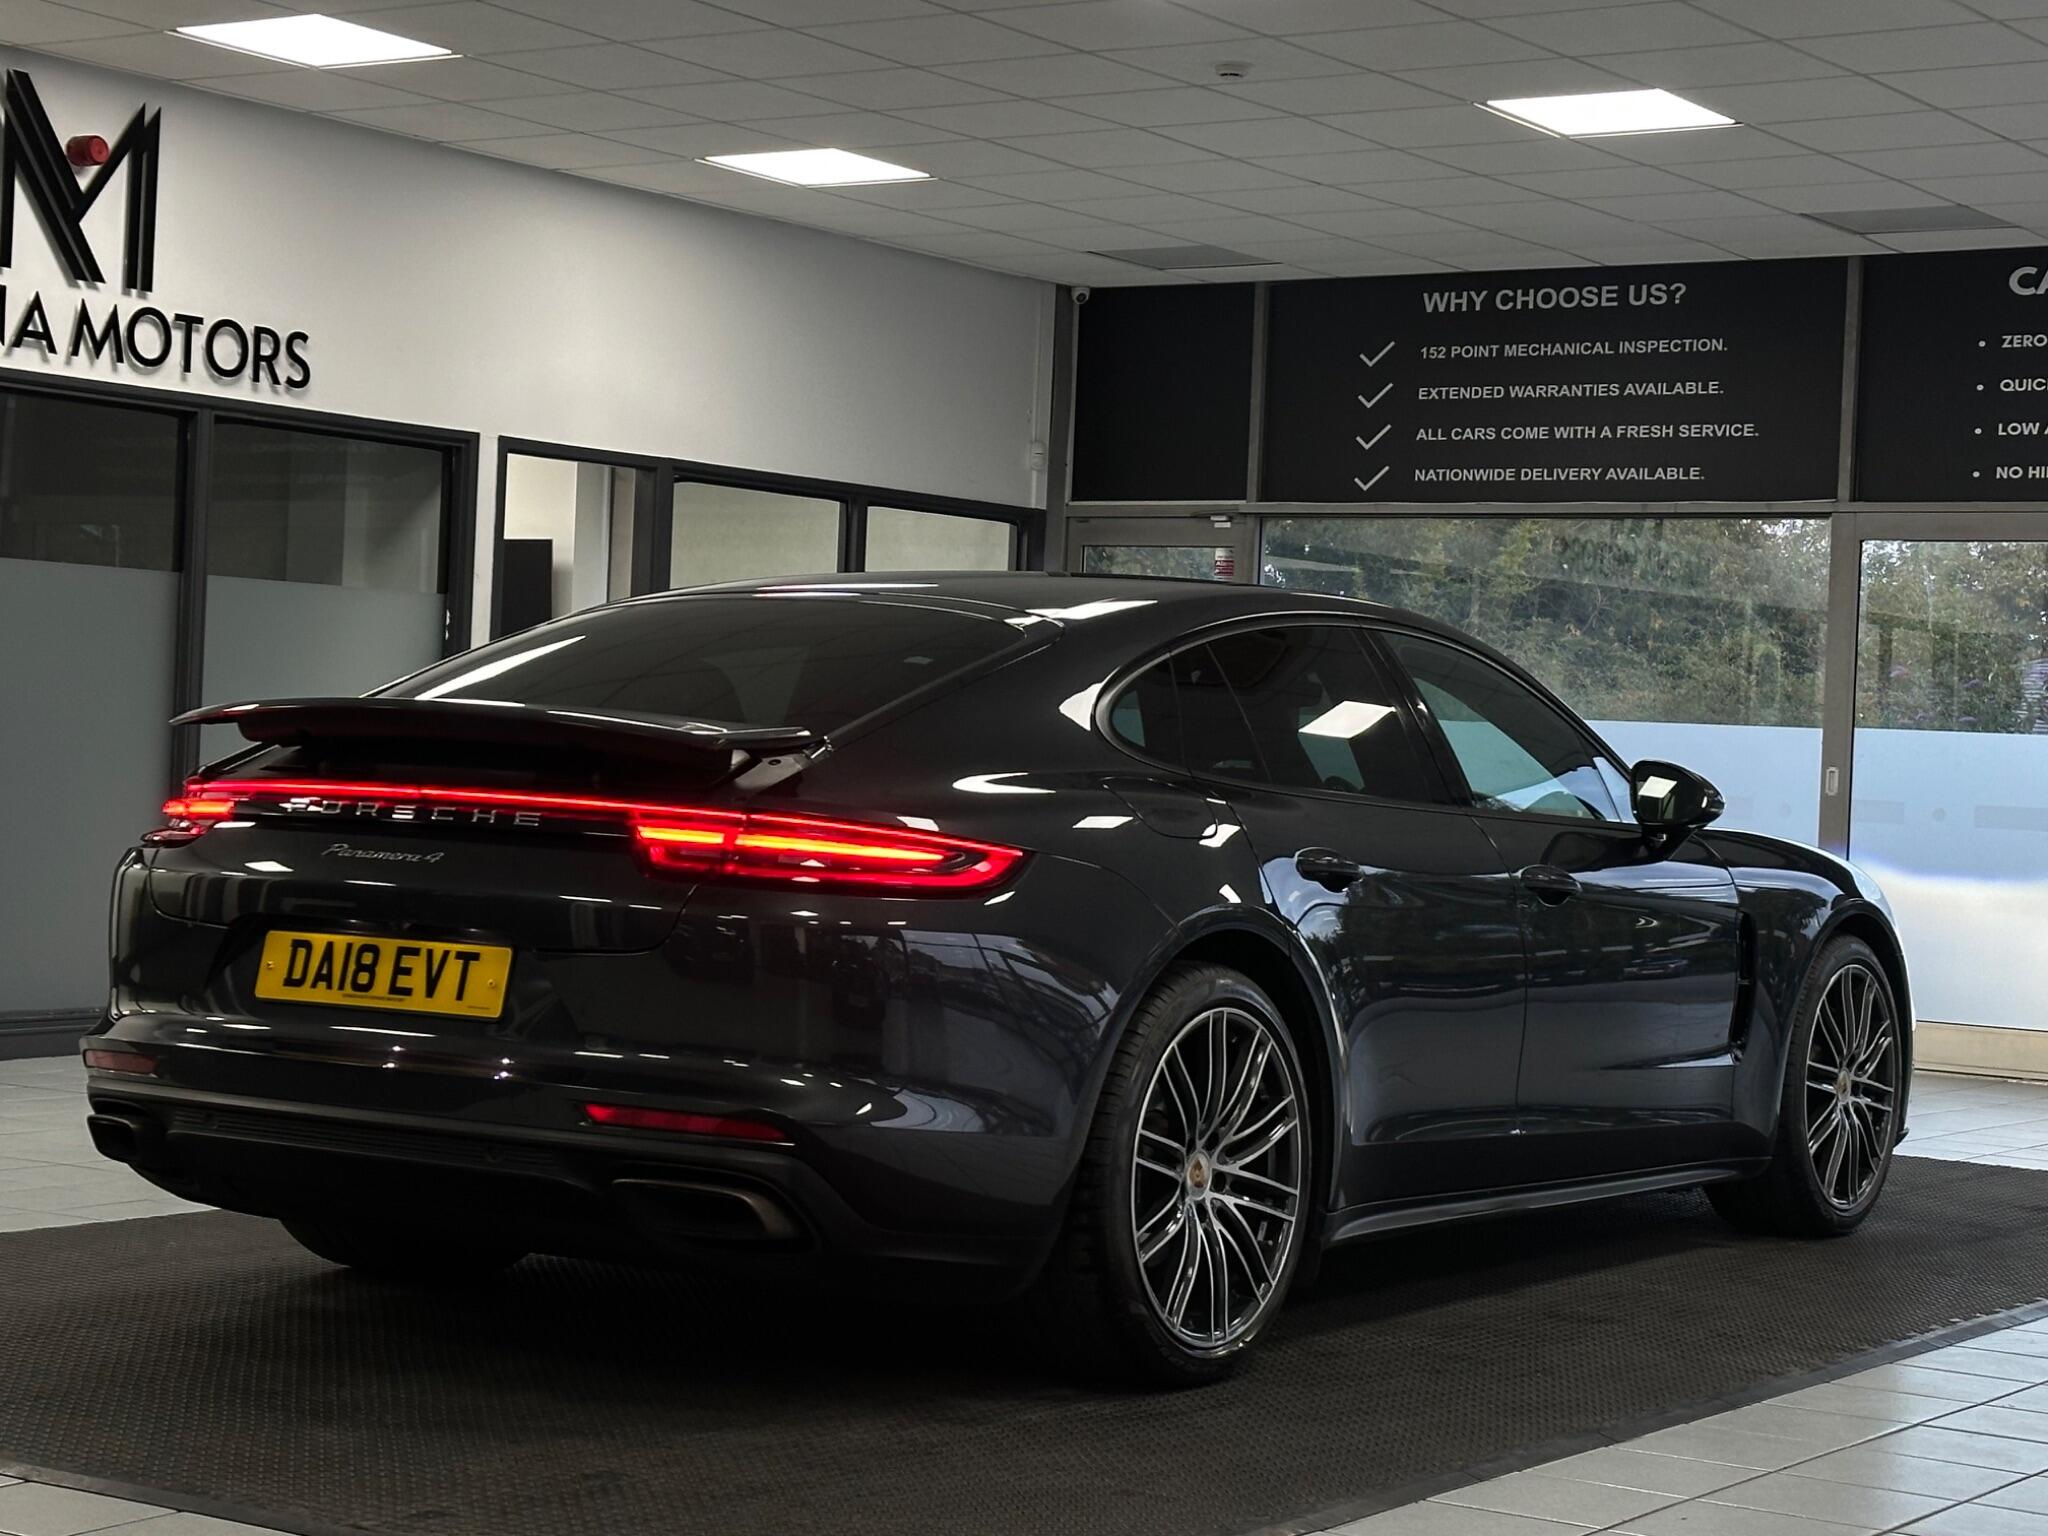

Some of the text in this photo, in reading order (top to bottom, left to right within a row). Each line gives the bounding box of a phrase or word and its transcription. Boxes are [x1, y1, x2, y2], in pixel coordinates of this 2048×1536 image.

[1424, 283, 1686, 312] WHY CHOOSE US?
[0, 285, 311, 389] A MOTORS
[2002, 335, 2047, 348] ZERO
[1421, 339, 1727, 358] 152 POINT MECHANICAL INSPECTION.
[1419, 382, 1723, 399] EXTENDED WARRANTIES AVAILABLE.
[2000, 379, 2048, 391] QUIC
[1416, 424, 1758, 440] ALL CARS COME WITH A FRESH SERVICE.
[1998, 422, 2039, 435] LOW
[1415, 467, 1704, 481] NATIONWIDE DELIVERY AVAILABLE.
[1996, 466, 2048, 479] NO HI
[287, 797, 541, 827] PORSCHE
[321, 842, 445, 863] Panamera 4
[282, 938, 480, 1001] DA18 EVT
